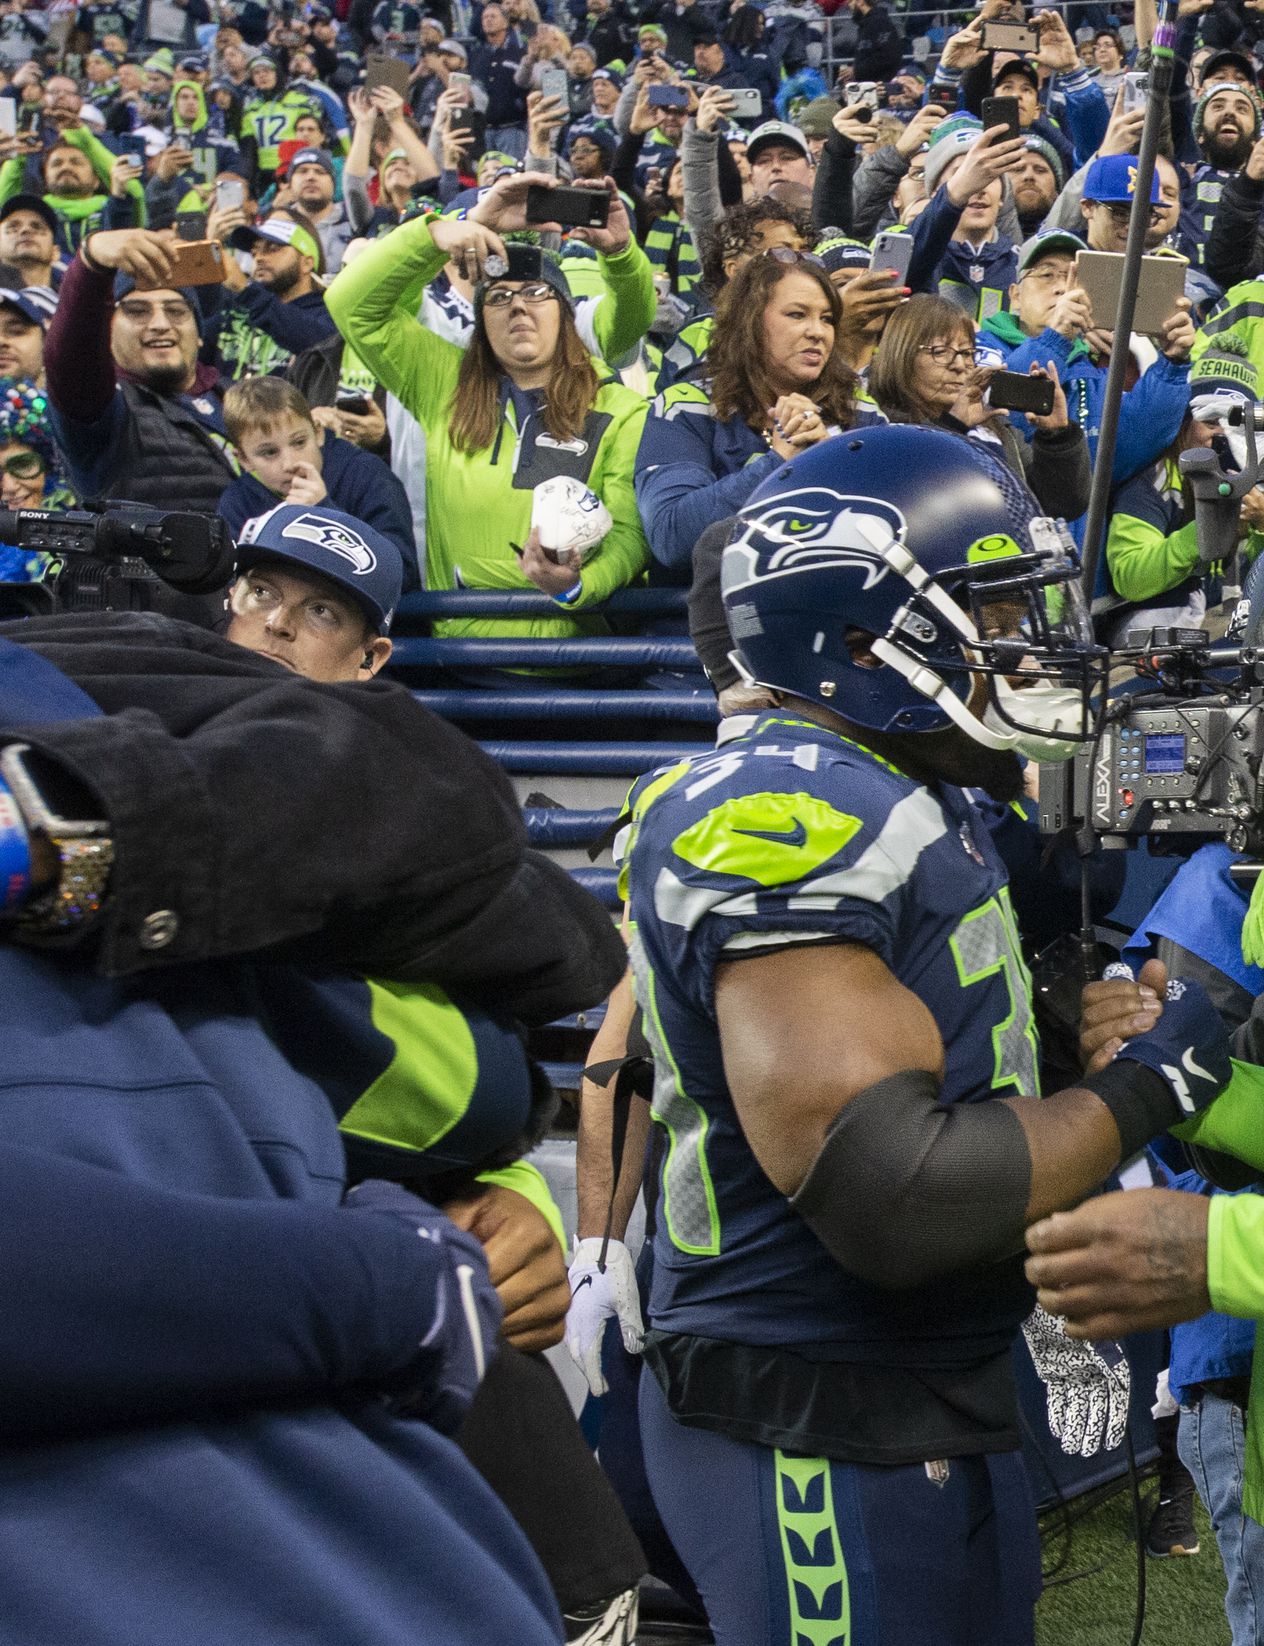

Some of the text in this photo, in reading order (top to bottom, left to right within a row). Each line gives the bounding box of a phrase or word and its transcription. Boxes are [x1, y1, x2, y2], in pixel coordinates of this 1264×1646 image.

[254, 114, 288, 148] 12
[191, 147, 218, 184] 4
[19, 510, 50, 520] SONY
[1096, 754, 1111, 824] ALEXA
